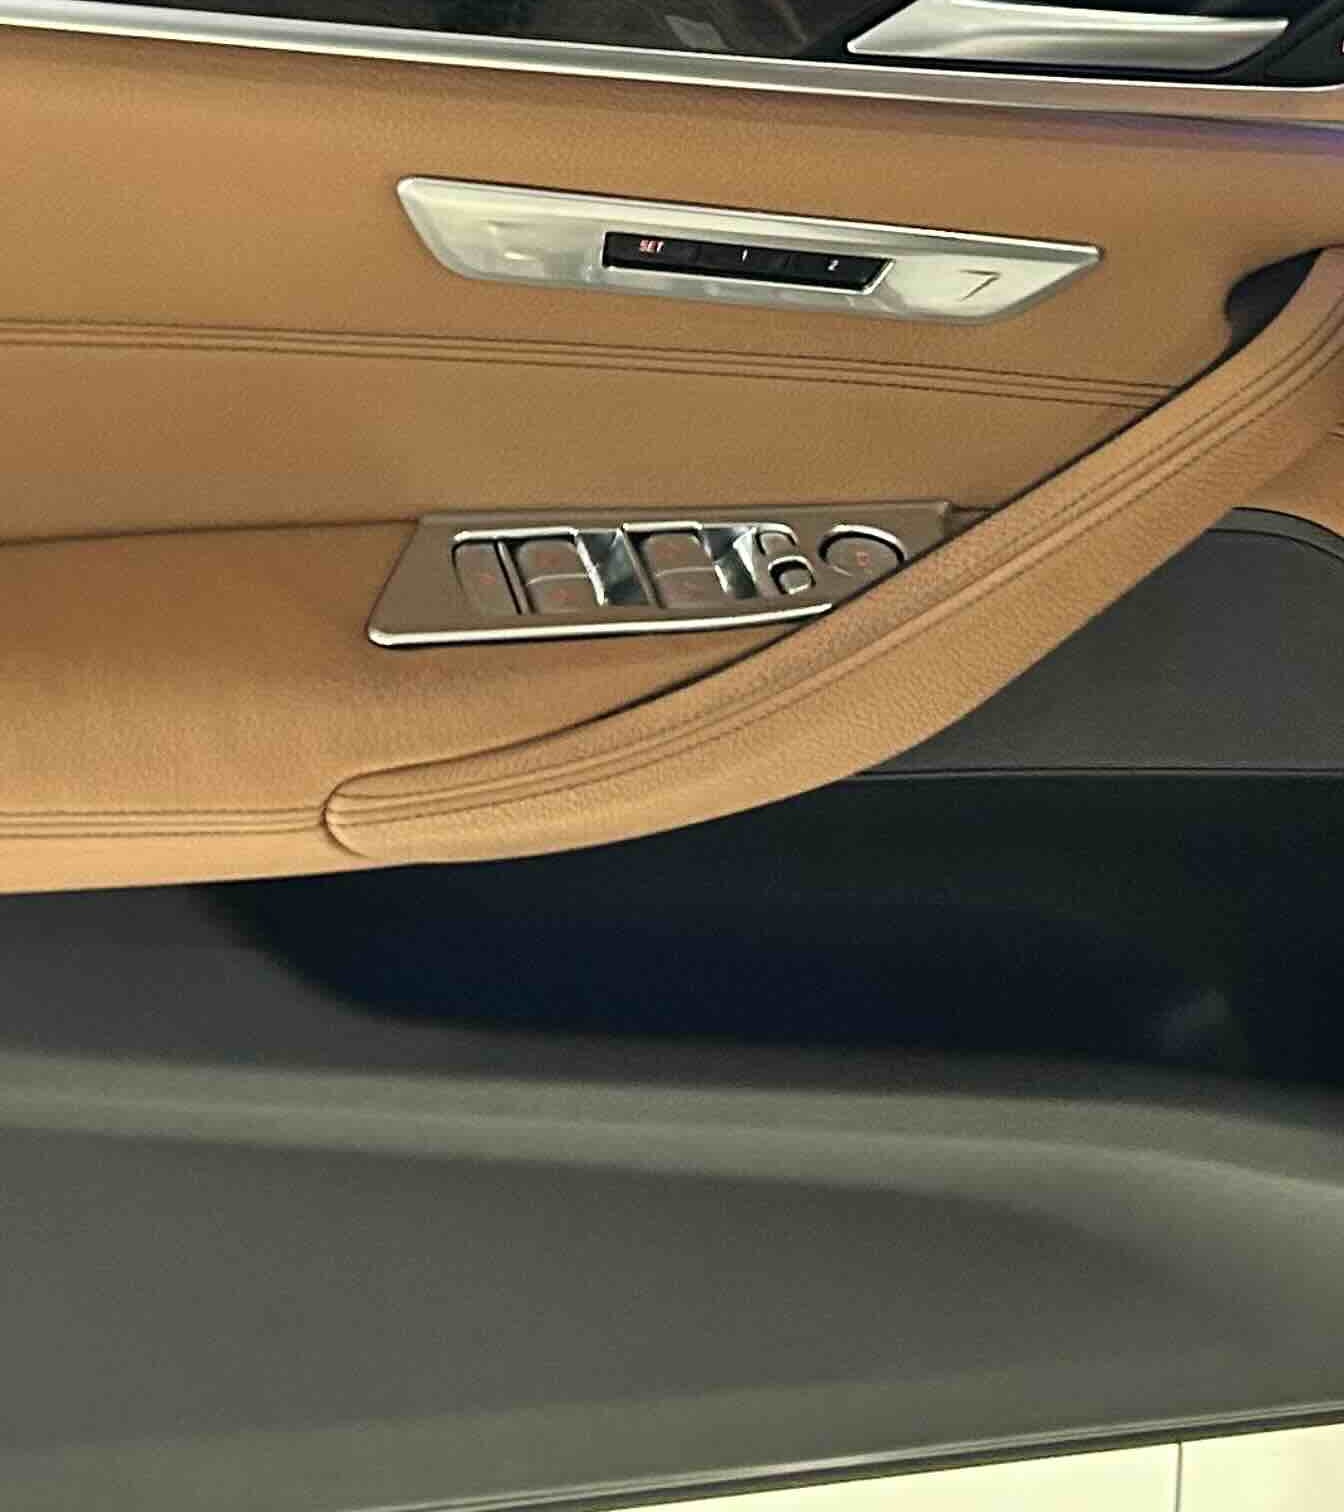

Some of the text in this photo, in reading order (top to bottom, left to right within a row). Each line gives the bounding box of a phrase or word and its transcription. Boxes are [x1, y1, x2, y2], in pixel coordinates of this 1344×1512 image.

[639, 239, 840, 272] SET 1 2
